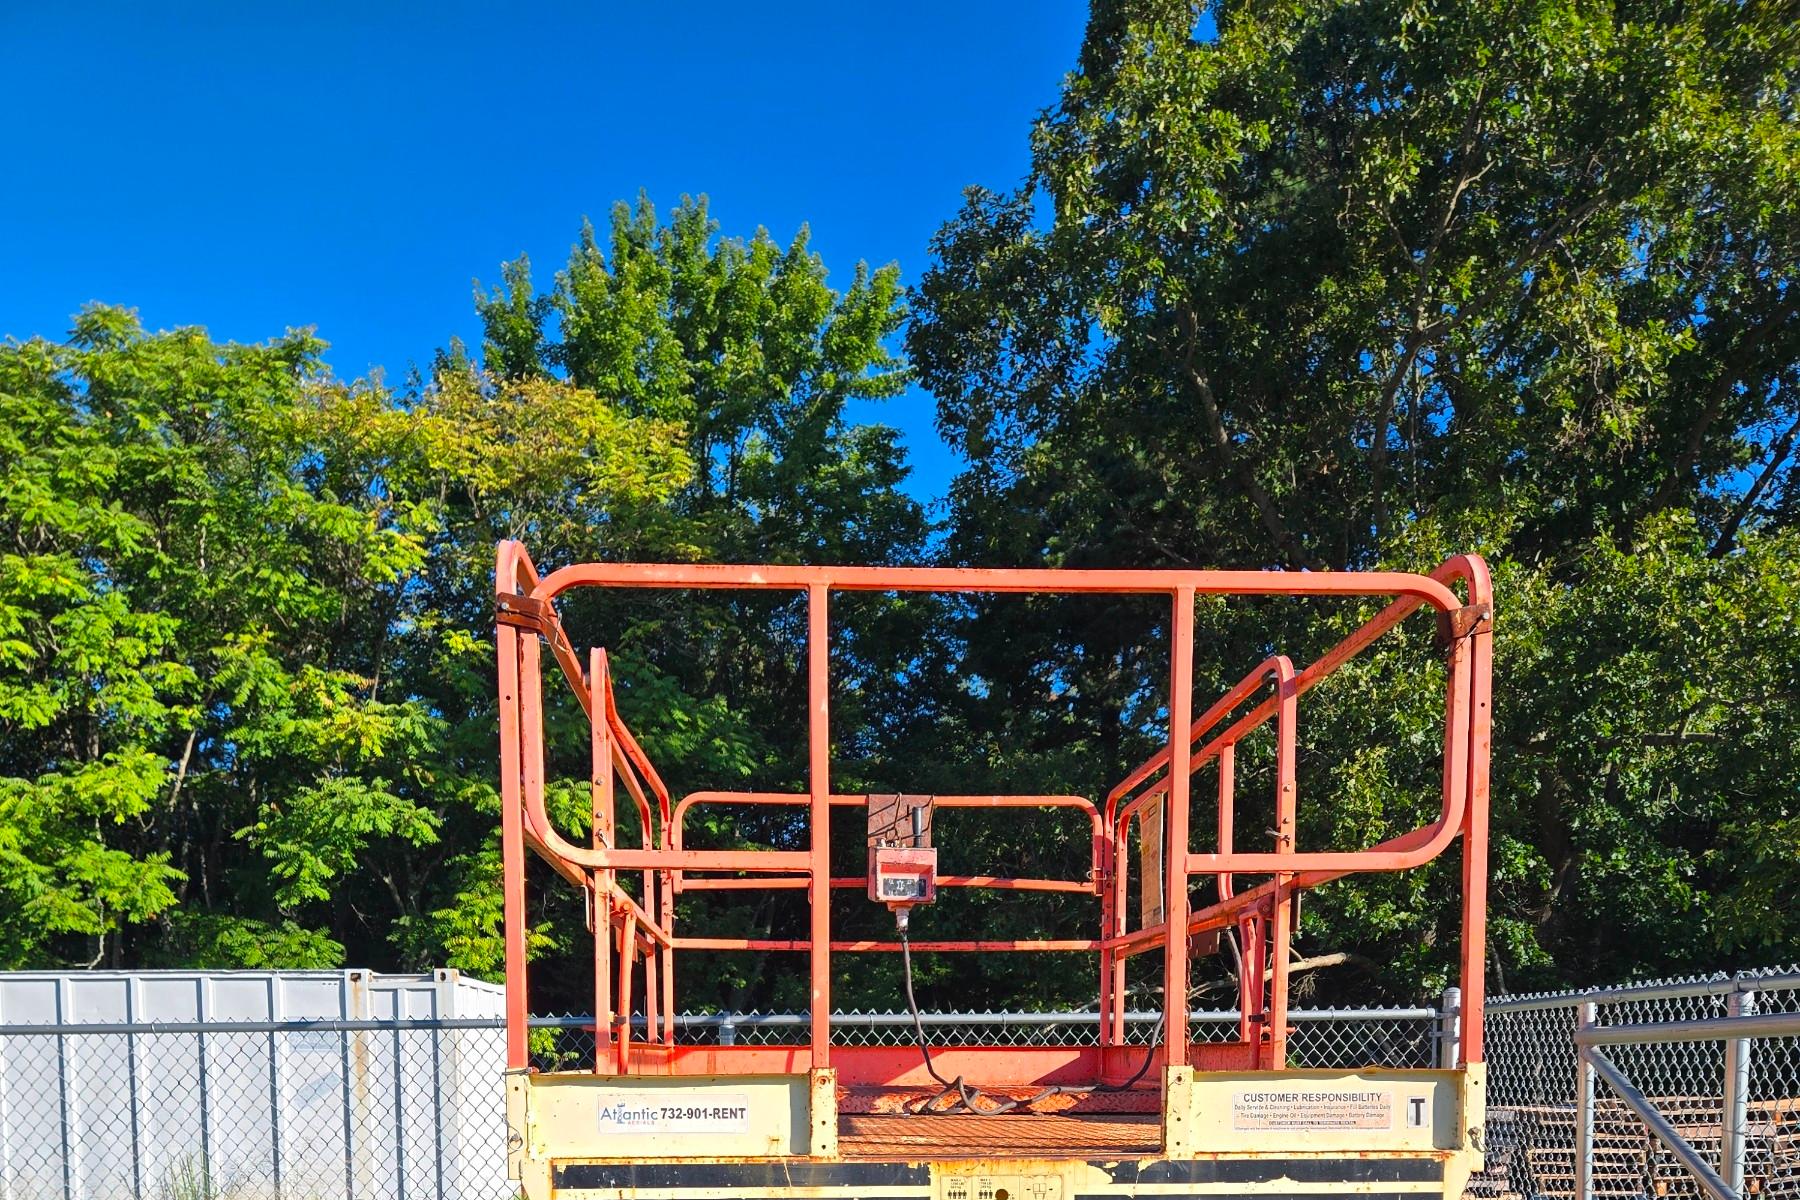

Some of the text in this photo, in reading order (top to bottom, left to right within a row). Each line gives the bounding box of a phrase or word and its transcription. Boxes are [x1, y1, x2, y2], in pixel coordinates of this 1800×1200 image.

[1243, 1092, 1382, 1102] CUSTOMER RESPONSIBILITY
[601, 1104, 746, 1122] Atlantic 732-901-RENT
[1410, 1098, 1425, 1126] T
